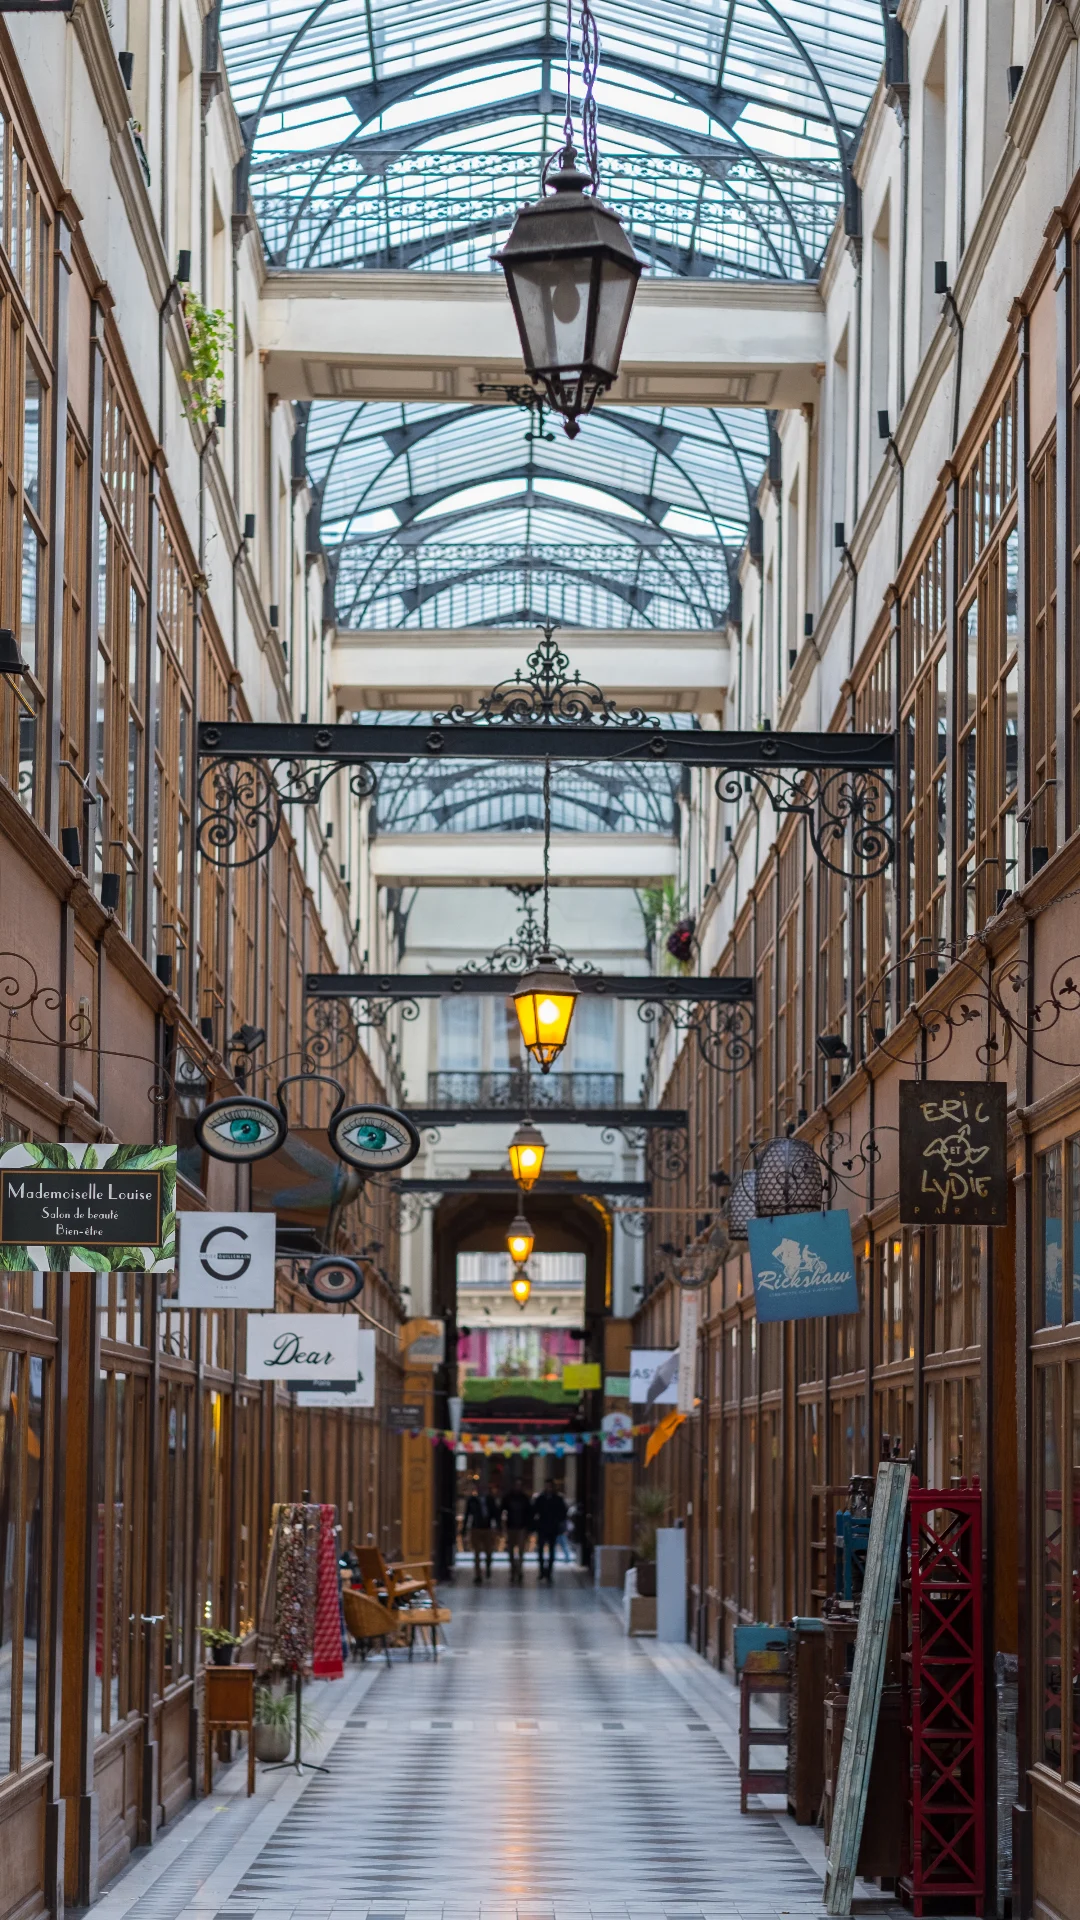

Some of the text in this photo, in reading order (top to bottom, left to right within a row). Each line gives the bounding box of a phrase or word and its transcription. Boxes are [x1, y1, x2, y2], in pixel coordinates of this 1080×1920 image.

[920, 1091, 990, 1122] ERIC
[949, 1146, 962, 1155] ET
[8, 1182, 153, 1200] Mademoiselle Louise
[921, 1169, 991, 1213] LYDIE
[41, 1206, 119, 1220] Salon de beauté
[914, 1206, 997, 1215] PARIS
[55, 1223, 104, 1236] Bien-être
[757, 1266, 853, 1291] Rickshaw
[263, 1332, 336, 1367] Dear
